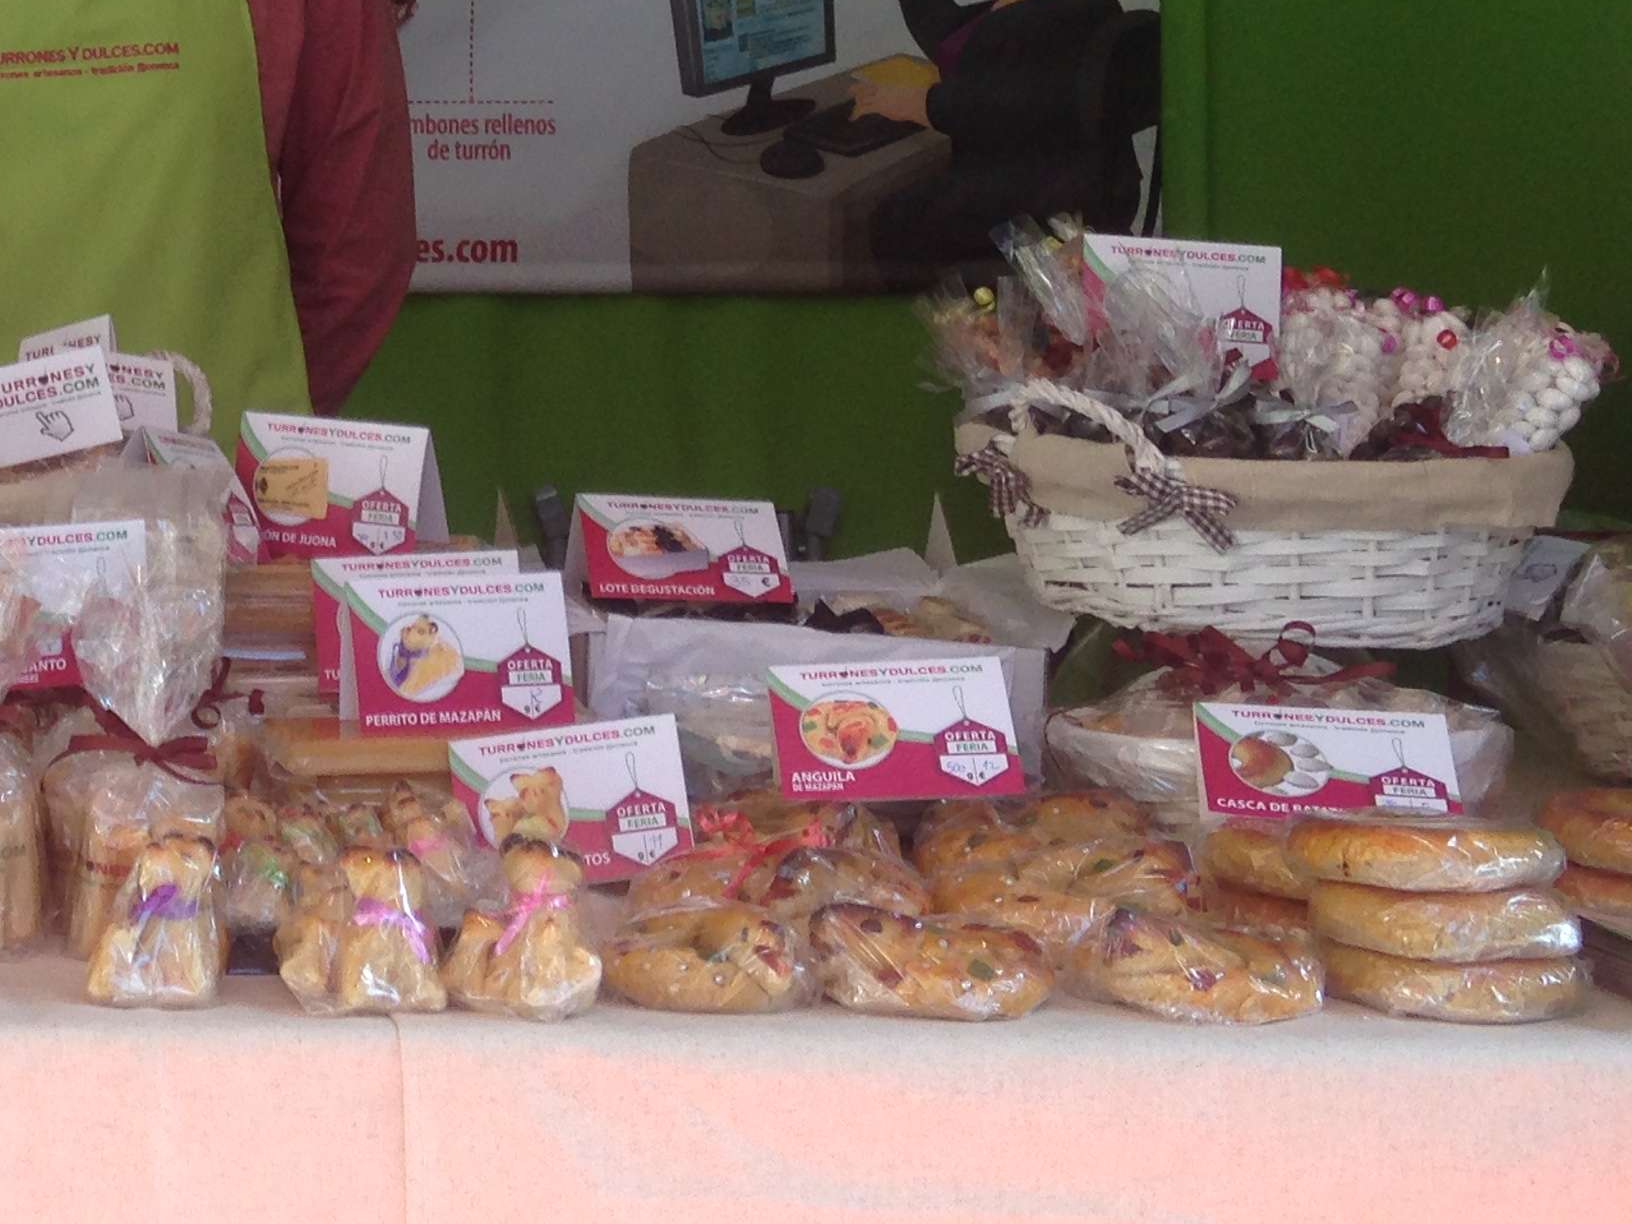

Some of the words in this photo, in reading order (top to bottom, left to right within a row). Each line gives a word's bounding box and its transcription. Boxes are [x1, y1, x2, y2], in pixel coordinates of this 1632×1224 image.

[410, 114, 479, 135] mbones
[485, 114, 556, 135] rellenos
[427, 139, 449, 160] de
[455, 139, 511, 160] turrón
[600, 583, 629, 594] LOTE
[507, 659, 553, 671] OFERTA
[365, 713, 418, 727] PERRITO
[420, 713, 436, 725] DE
[944, 731, 996, 742] OFERTA
[955, 742, 989, 752] FERIA
[792, 771, 855, 783] ANGUILA
[1381, 776, 1435, 787] OFERTA
[1392, 787, 1428, 796] FERIA
[616, 803, 666, 817] OFERTA
[1217, 798, 1266, 811] CASCA
[1270, 802, 1289, 813] DE
[626, 816, 659, 828] FERIA
[584, 852, 611, 866] TOS
